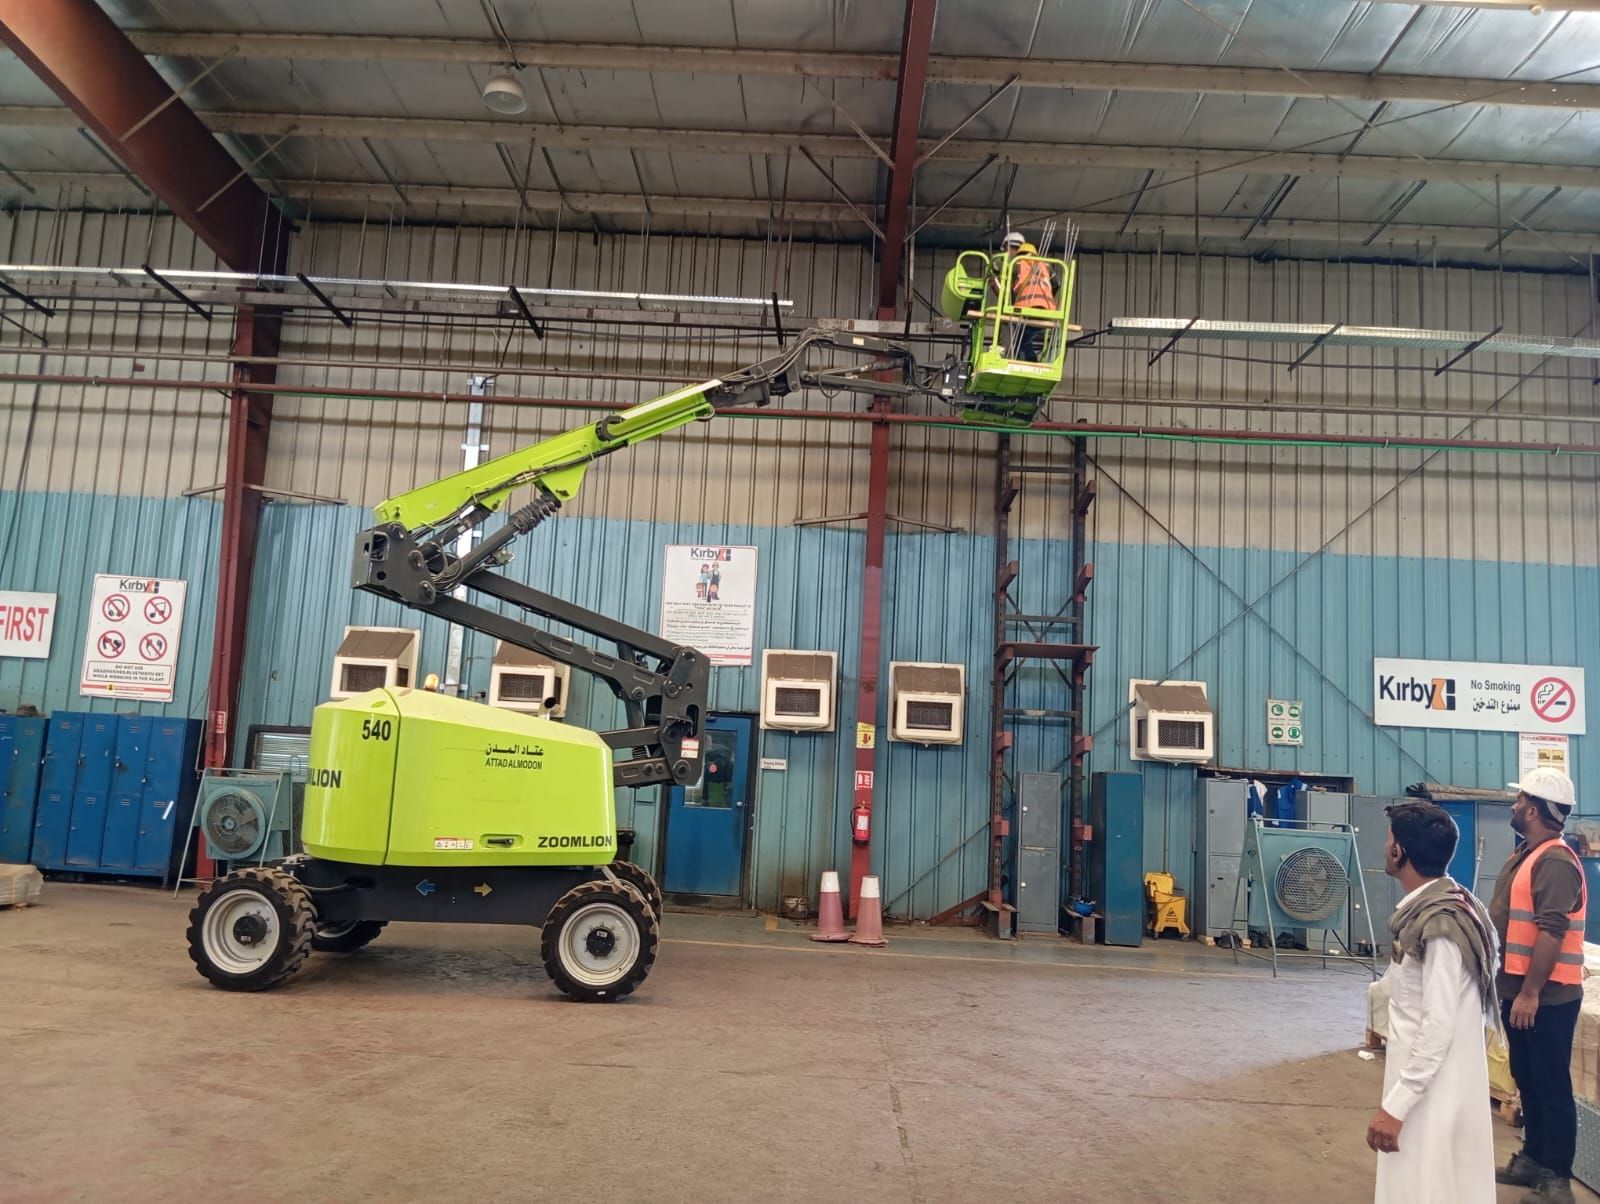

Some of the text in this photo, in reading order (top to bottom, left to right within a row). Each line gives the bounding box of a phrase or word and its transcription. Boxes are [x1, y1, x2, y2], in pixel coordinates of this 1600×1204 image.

[691, 547, 721, 561] Kirby
[120, 579, 150, 592] Kirby
[0, 606, 49, 642] FIRST
[1379, 675, 1437, 710] Kirby
[1471, 679, 1521, 694] No Smoking
[1472, 697, 1521, 714] ممنوع التدخين
[362, 719, 391, 741] 540
[538, 835, 612, 848] ZOOMLION
